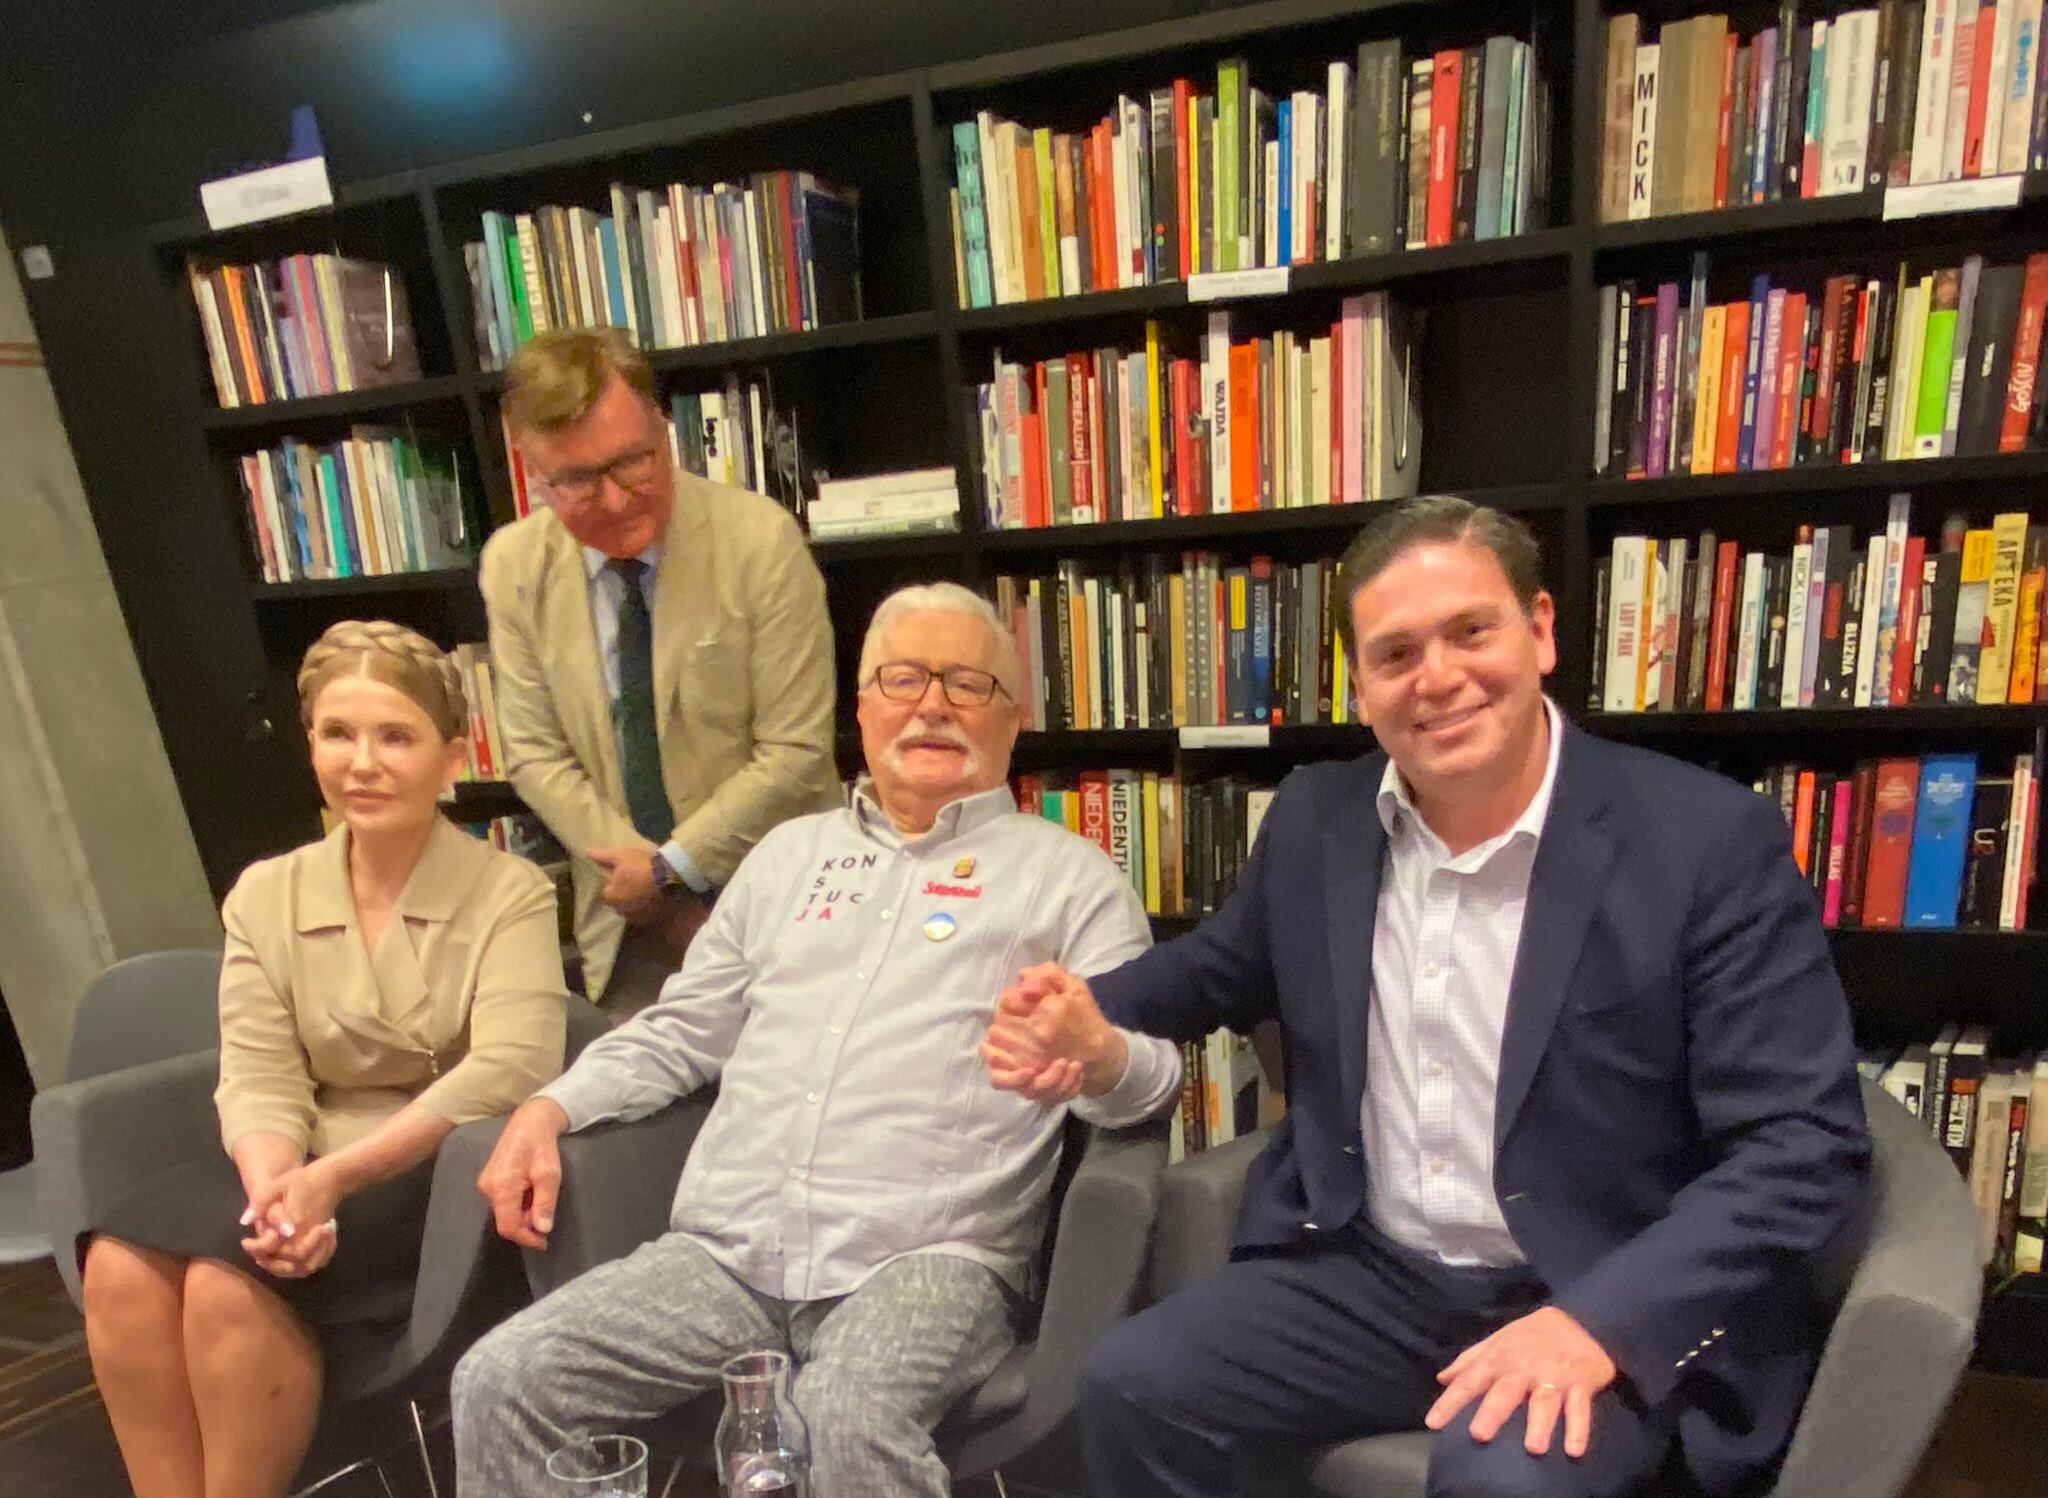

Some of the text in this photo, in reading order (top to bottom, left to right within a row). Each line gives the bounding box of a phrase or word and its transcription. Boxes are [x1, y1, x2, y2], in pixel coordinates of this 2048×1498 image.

[1633, 71, 1655, 201] MICK
[1214, 379, 1227, 438] WAJDA
[1869, 375, 1887, 428] Marek
[1794, 557, 1808, 590] NICK
[1993, 540, 2021, 608] APTEKA
[1618, 602, 1637, 628] LADY
[1840, 622, 1859, 678] BLIZNA
[813, 876, 826, 889] S
[822, 854, 878, 872] KON
